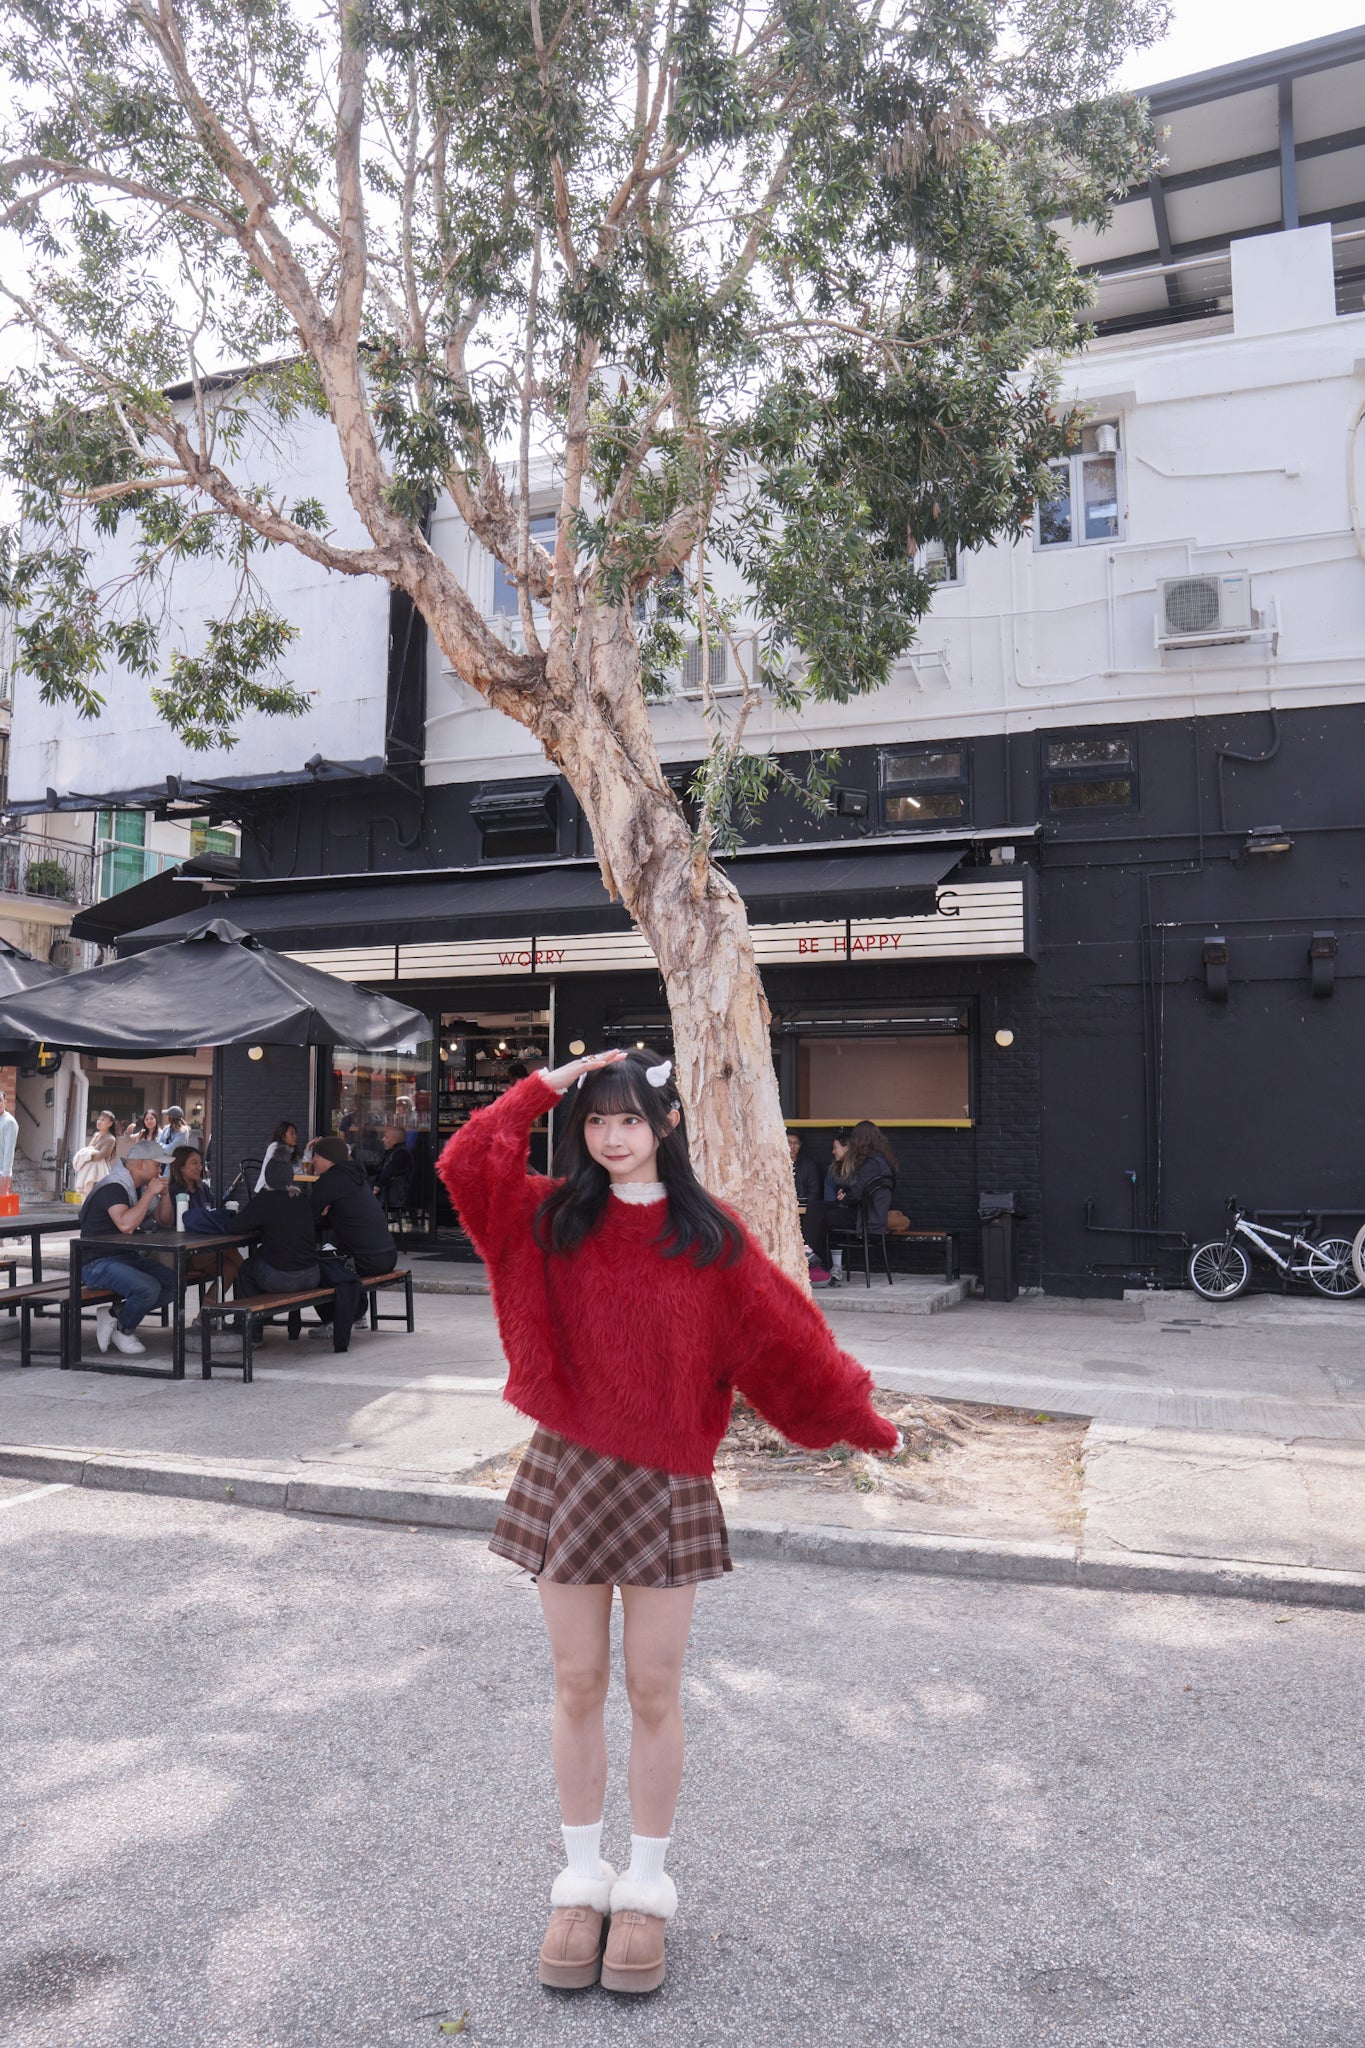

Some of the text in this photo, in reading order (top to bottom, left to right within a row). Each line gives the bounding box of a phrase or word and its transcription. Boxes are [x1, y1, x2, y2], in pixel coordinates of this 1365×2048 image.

[498, 934, 902, 967] WORRY BE HAPPY
